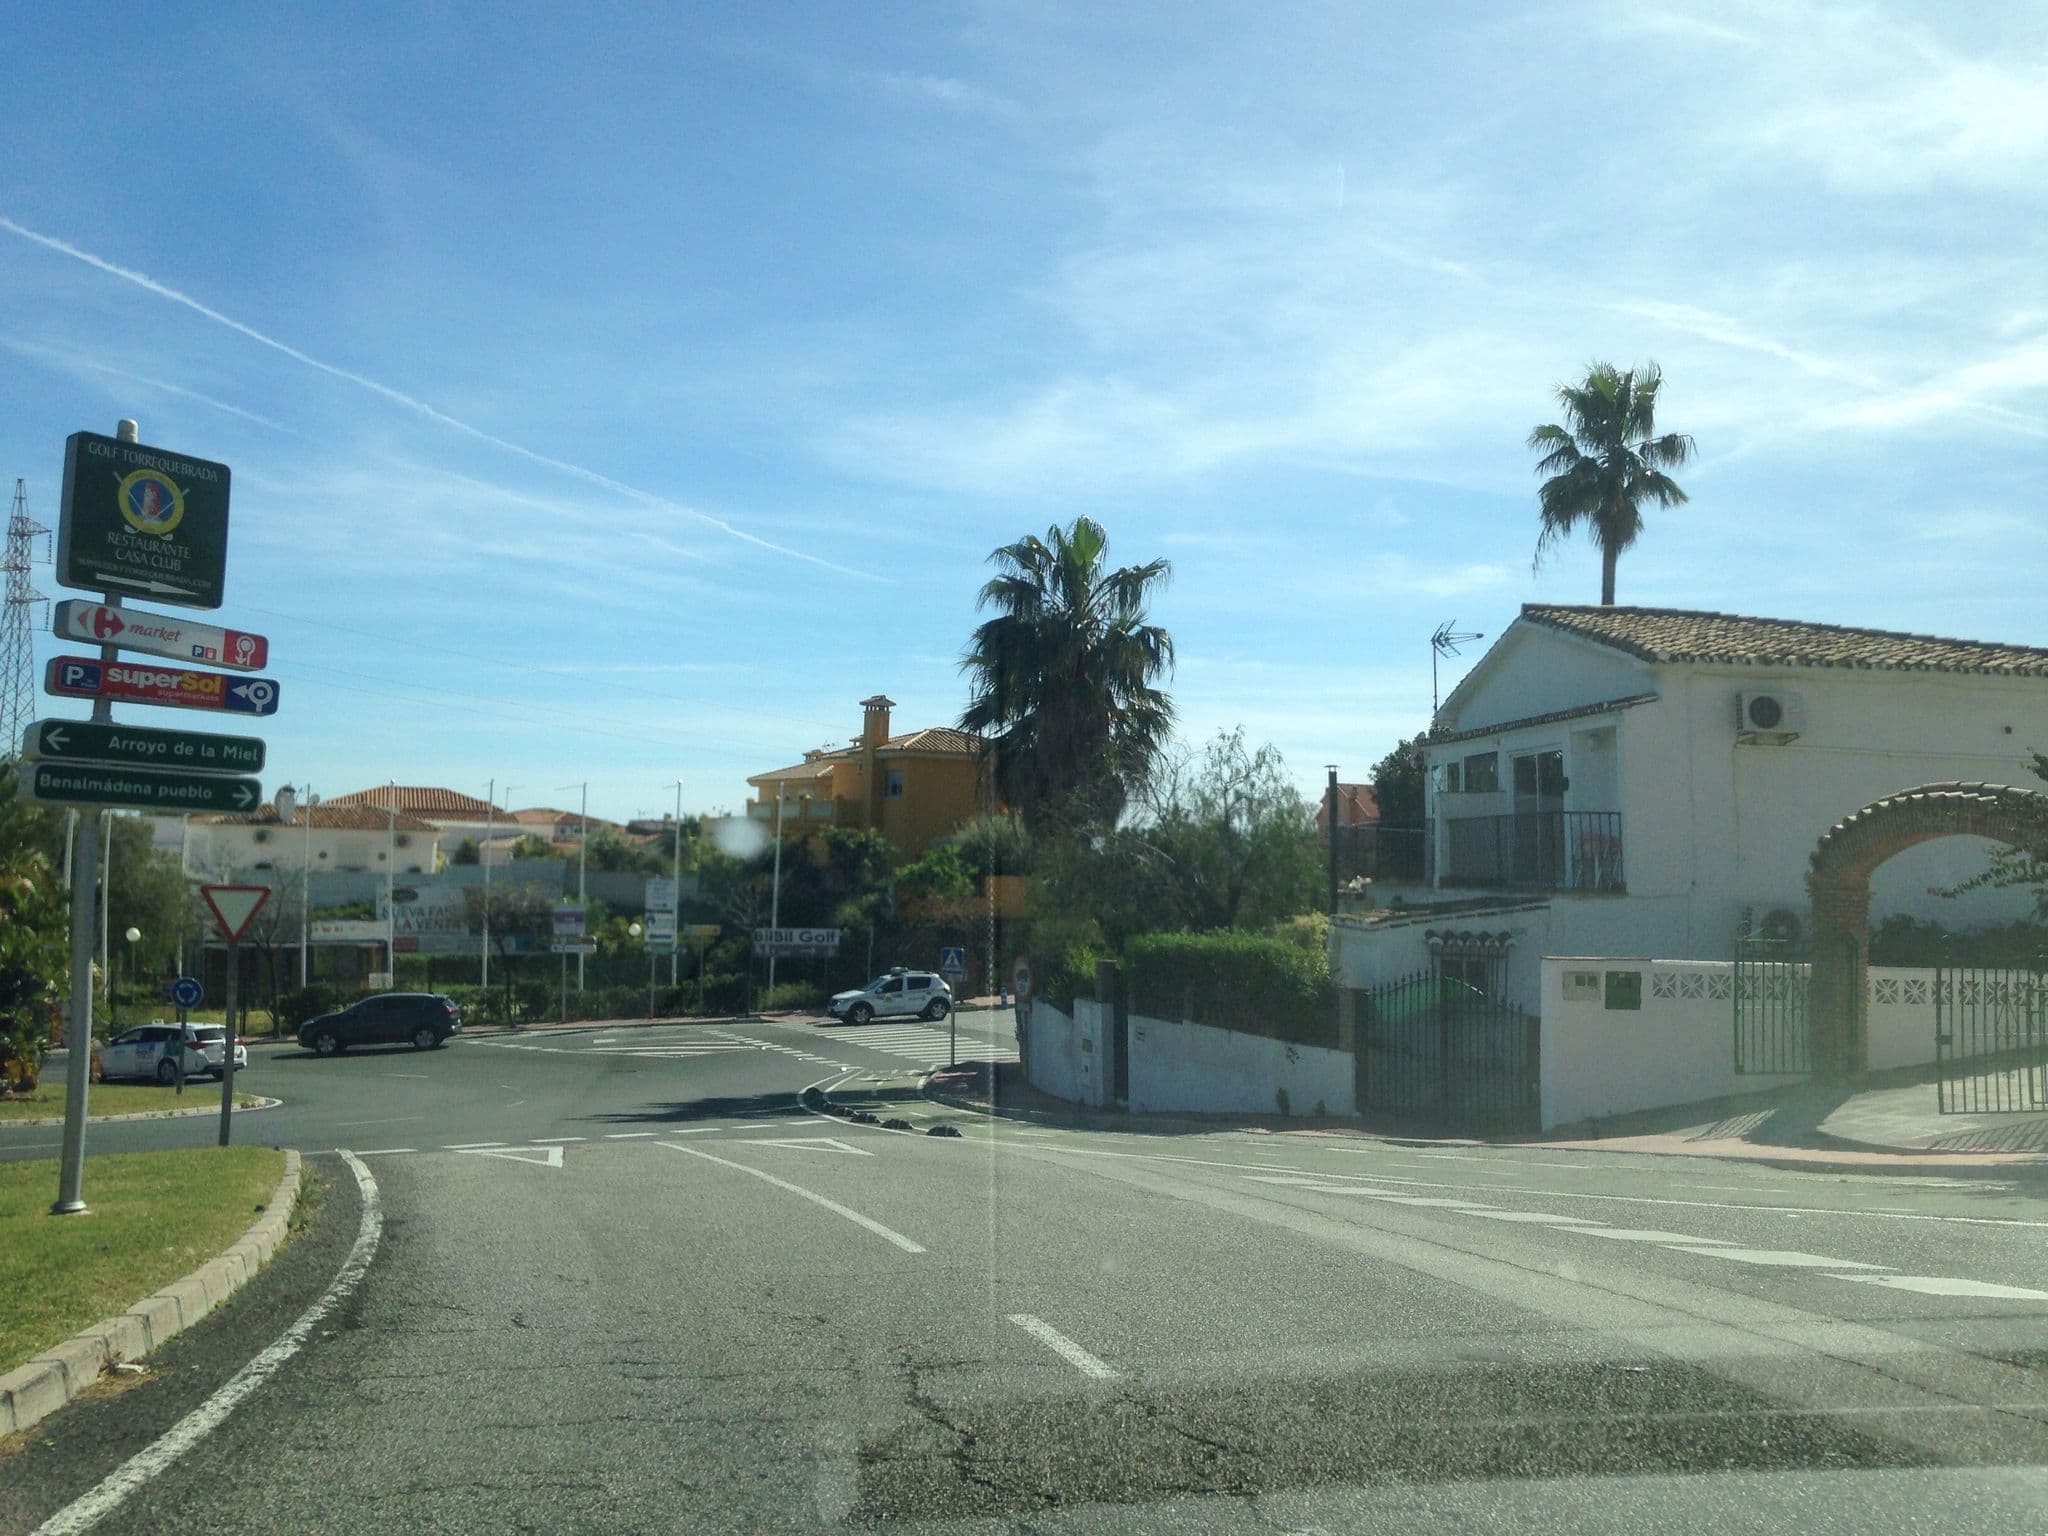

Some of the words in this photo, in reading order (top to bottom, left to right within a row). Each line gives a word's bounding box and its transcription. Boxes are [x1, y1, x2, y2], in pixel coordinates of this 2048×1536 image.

[88, 441, 118, 458] GOLF
[122, 449, 219, 482] TORREQUEBRADA
[108, 531, 192, 559] RESTAURANTE
[115, 549, 148, 565] CASA
[152, 555, 181, 571] CLUB
[129, 624, 182, 642] market
[66, 665, 84, 685] P
[108, 736, 166, 755] Arroyo
[174, 740, 194, 756] de
[201, 741, 215, 758] la
[223, 744, 258, 761] Miel
[40, 775, 151, 796] Benalmádena
[159, 780, 212, 799] pueblo
[799, 930, 835, 944] Golf
